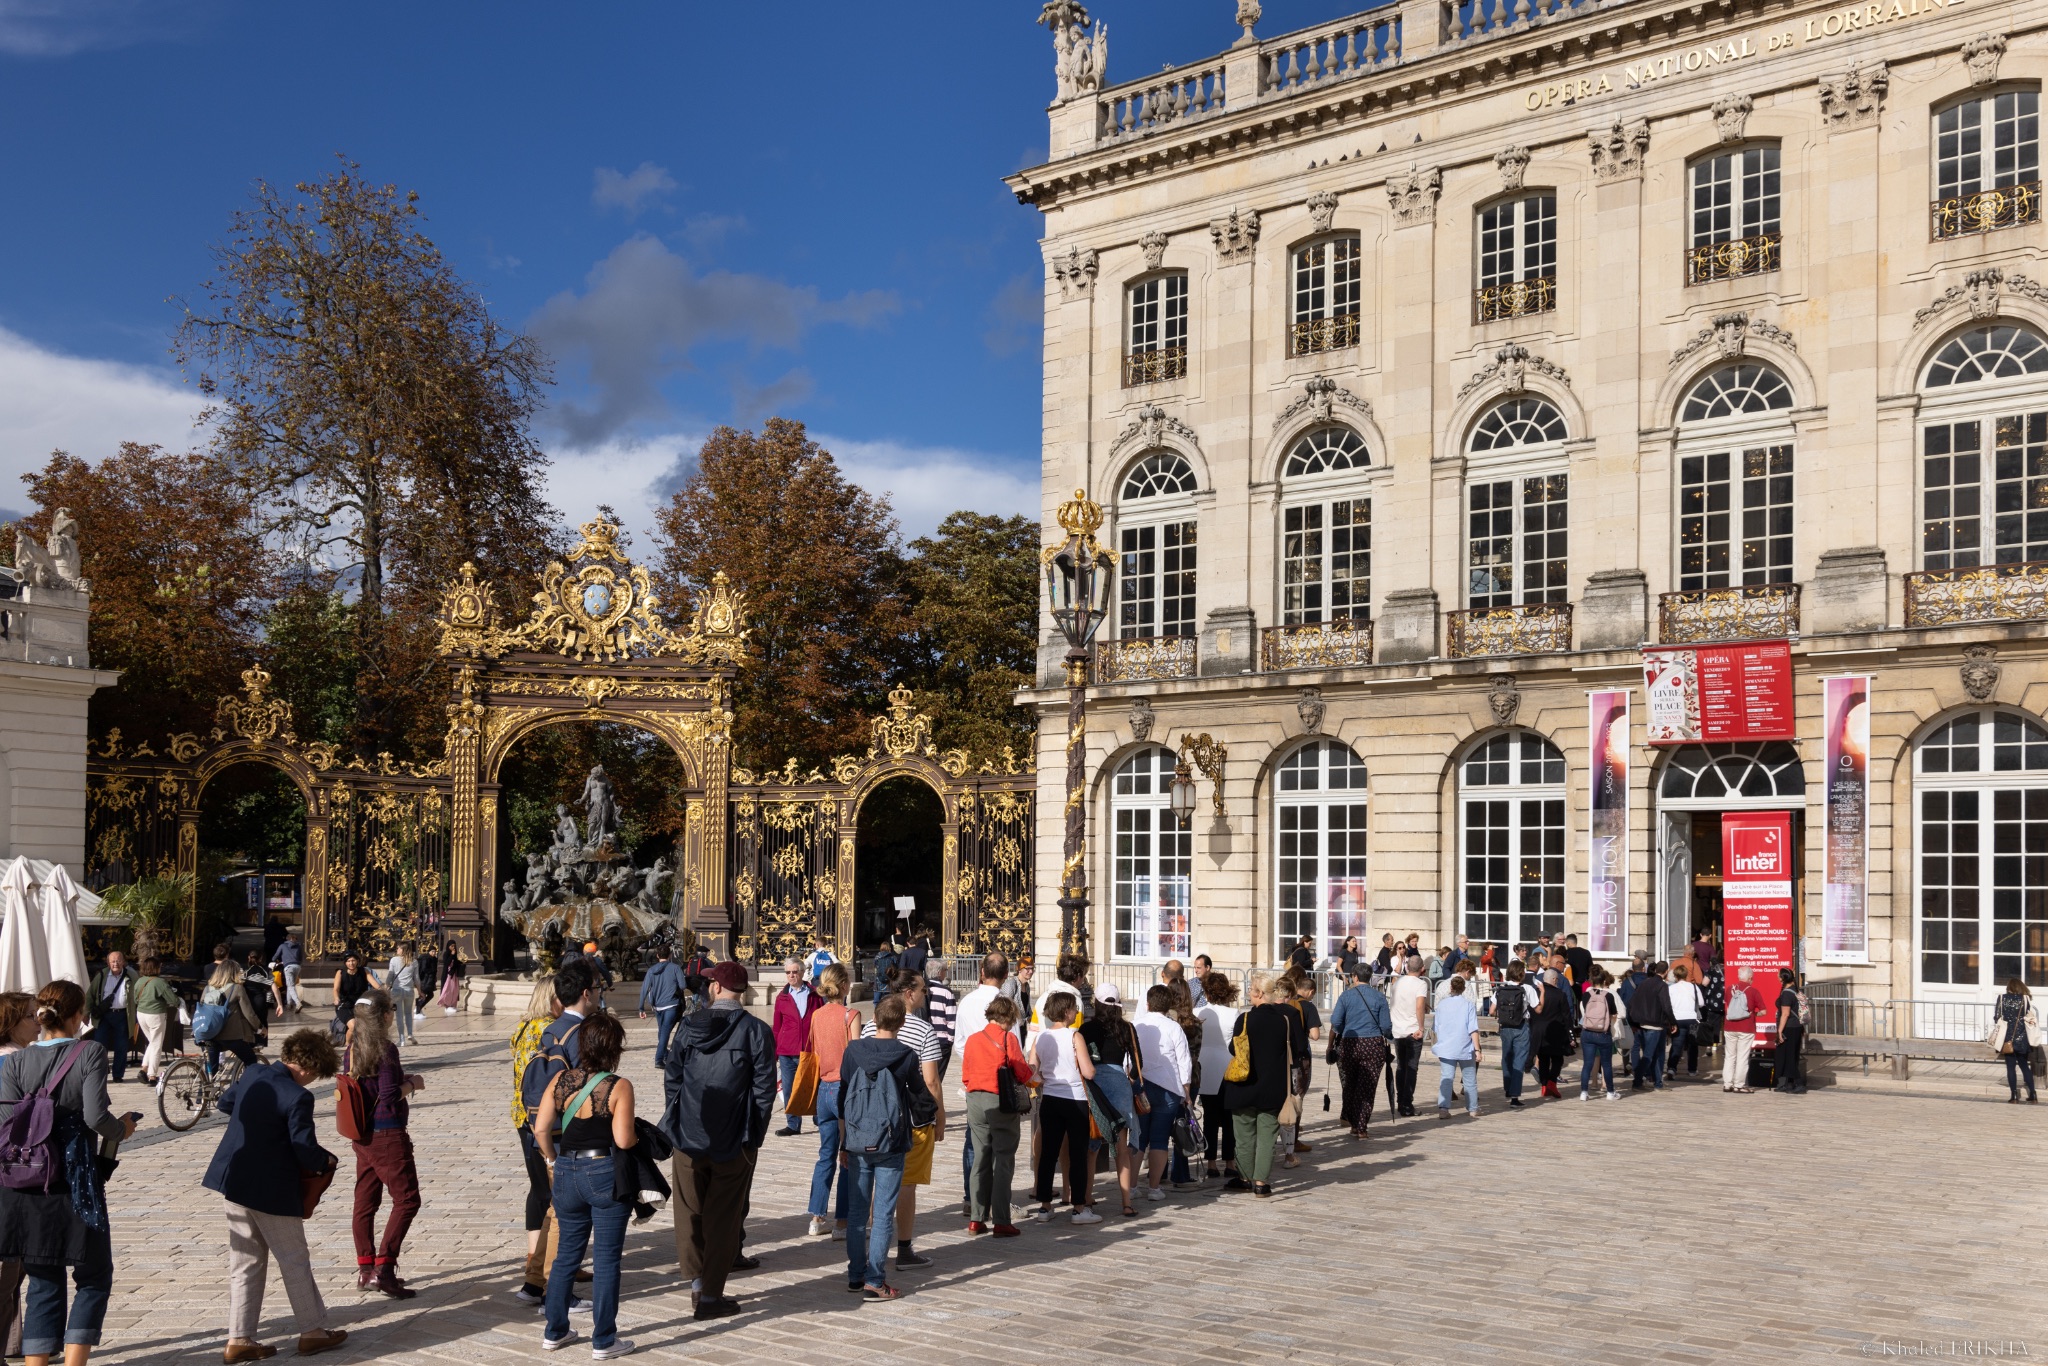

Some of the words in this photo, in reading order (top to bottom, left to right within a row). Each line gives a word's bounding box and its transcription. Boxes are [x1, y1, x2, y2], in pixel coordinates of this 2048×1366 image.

[1525, 73, 1613, 111] OPERA
[1624, 37, 1756, 88] NATIONAL
[1704, 655, 1730, 664] OPÉRA
[1654, 702, 1682, 710] PLACE
[1736, 854, 1777, 870] inter
